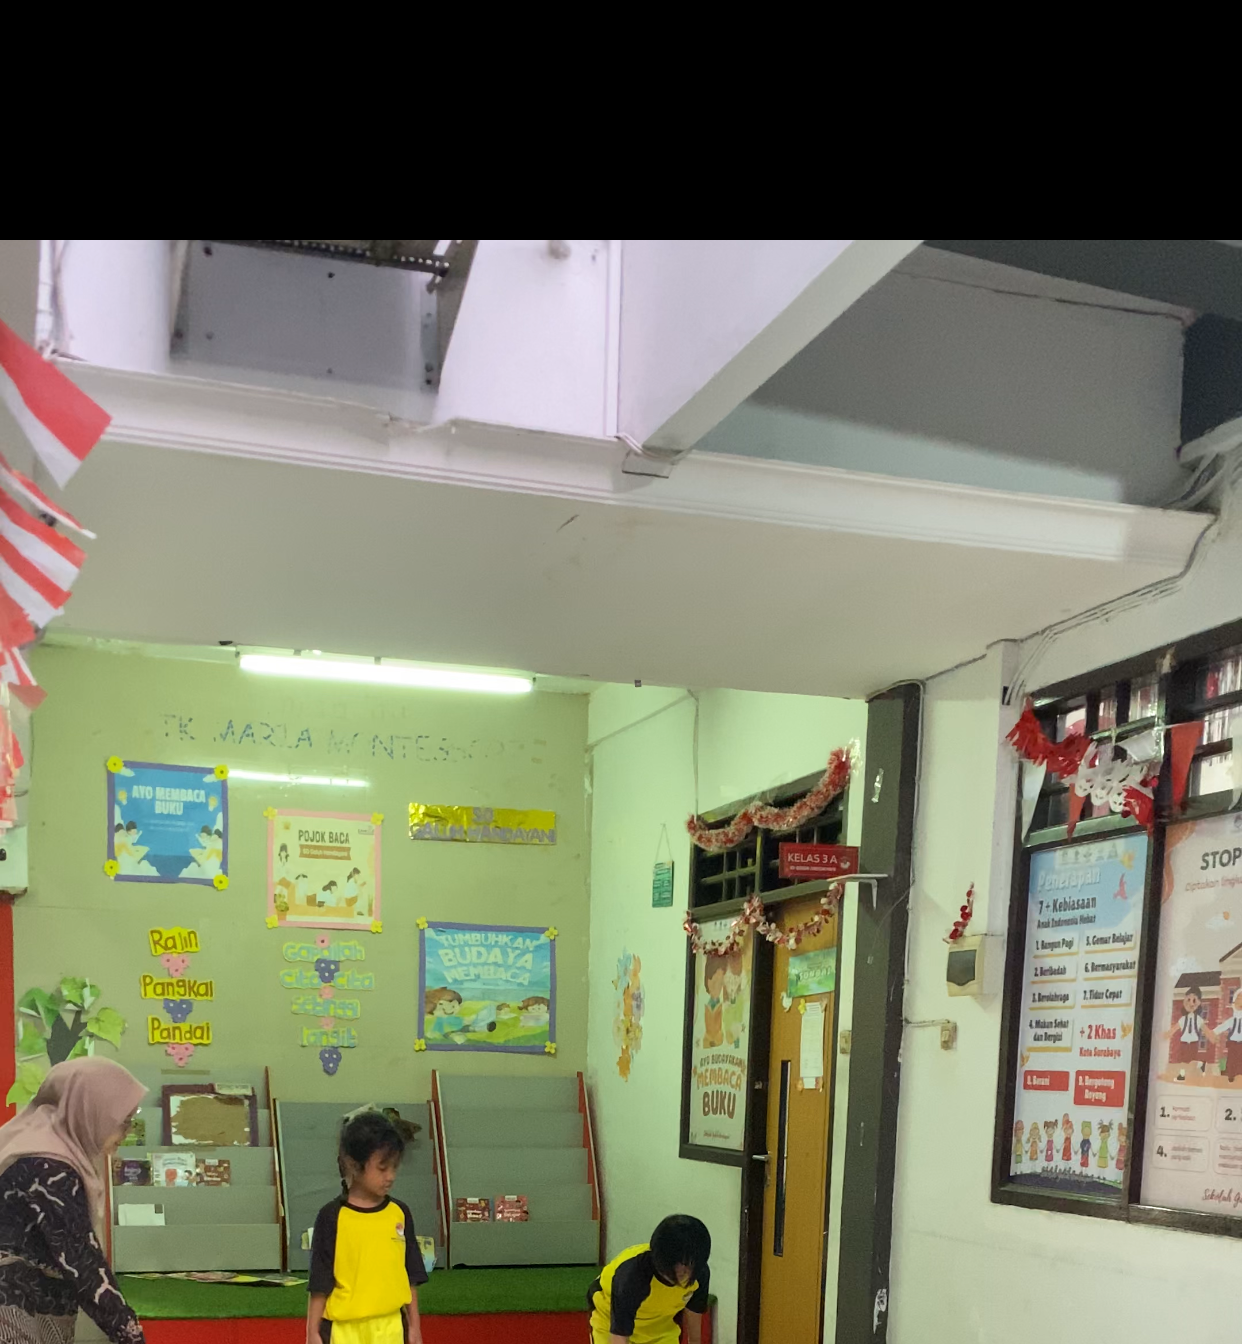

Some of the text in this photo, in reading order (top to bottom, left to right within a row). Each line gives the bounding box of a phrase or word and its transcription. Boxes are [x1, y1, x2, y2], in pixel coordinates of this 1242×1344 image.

[132, 785, 206, 803] AYO MEMBACA
[155, 800, 183, 815] BUKU
[298, 829, 326, 843] POJOK
[328, 831, 350, 844] BACA
[787, 853, 838, 864] KELAS 3 A
[1200, 847, 1242, 871] STOP
[1038, 900, 1044, 915] 7
[1052, 896, 1097, 914] Kebiasaan
[440, 933, 536, 951] TUMBUHKAN
[1061, 937, 1074, 950] Pagi
[438, 946, 533, 970] BUDAYA
[443, 965, 531, 985] MEMBACA
[142, 974, 214, 998] Pangkal
[150, 1017, 211, 1042] Pandai
[1034, 1019, 1053, 1029] Makan
[1087, 1024, 1093, 1040] 2
[1094, 1023, 1116, 1040] Khas
[1033, 1032, 1043, 1042] dan
[1079, 1047, 1092, 1057] Kota
[696, 1067, 742, 1092] MEMBACA
[703, 1089, 736, 1119] BUKU
[1159, 1106, 1170, 1118] 1.
[1224, 1108, 1237, 1121] 2.
[1156, 1145, 1167, 1158] 4.
